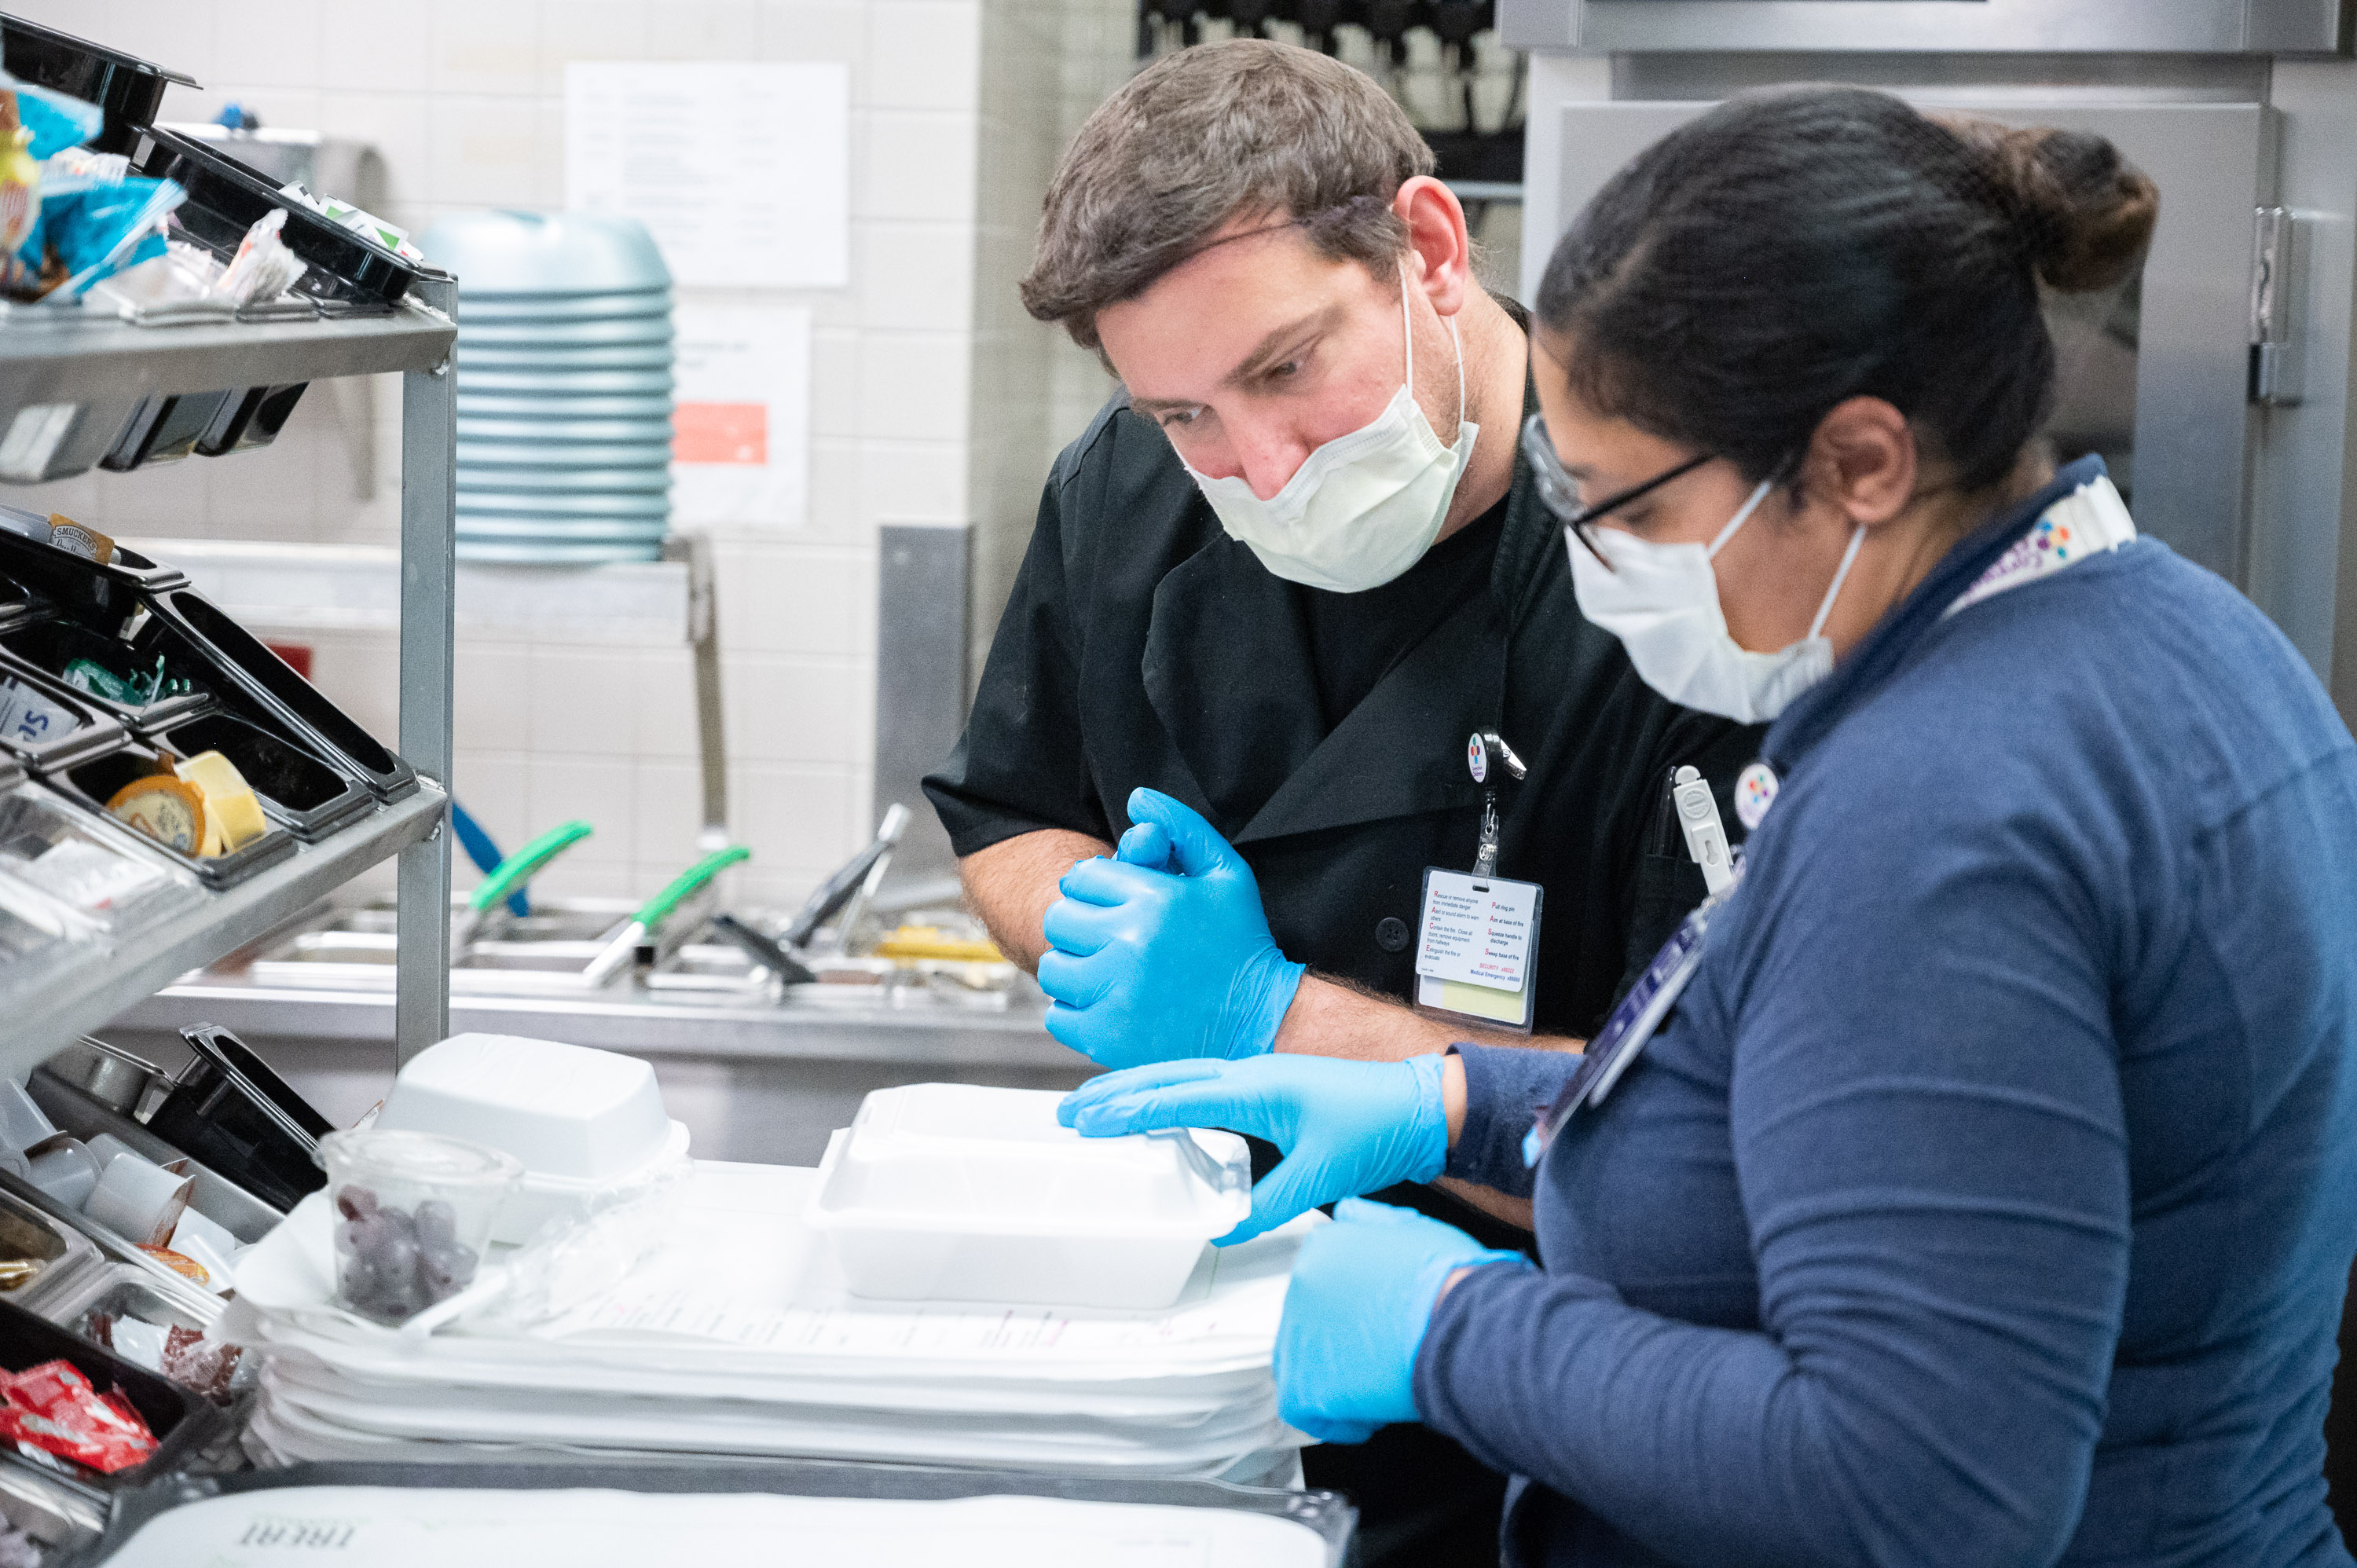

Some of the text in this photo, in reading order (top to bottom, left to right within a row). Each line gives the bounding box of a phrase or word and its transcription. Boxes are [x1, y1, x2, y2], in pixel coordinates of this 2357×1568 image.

[1492, 901, 1500, 910] Pull
[1488, 928, 1504, 937] Squeeze
[1490, 938, 1508, 946] discharge
[1485, 948, 1498, 958] Sweep
[1485, 971, 1506, 981] Emergency
